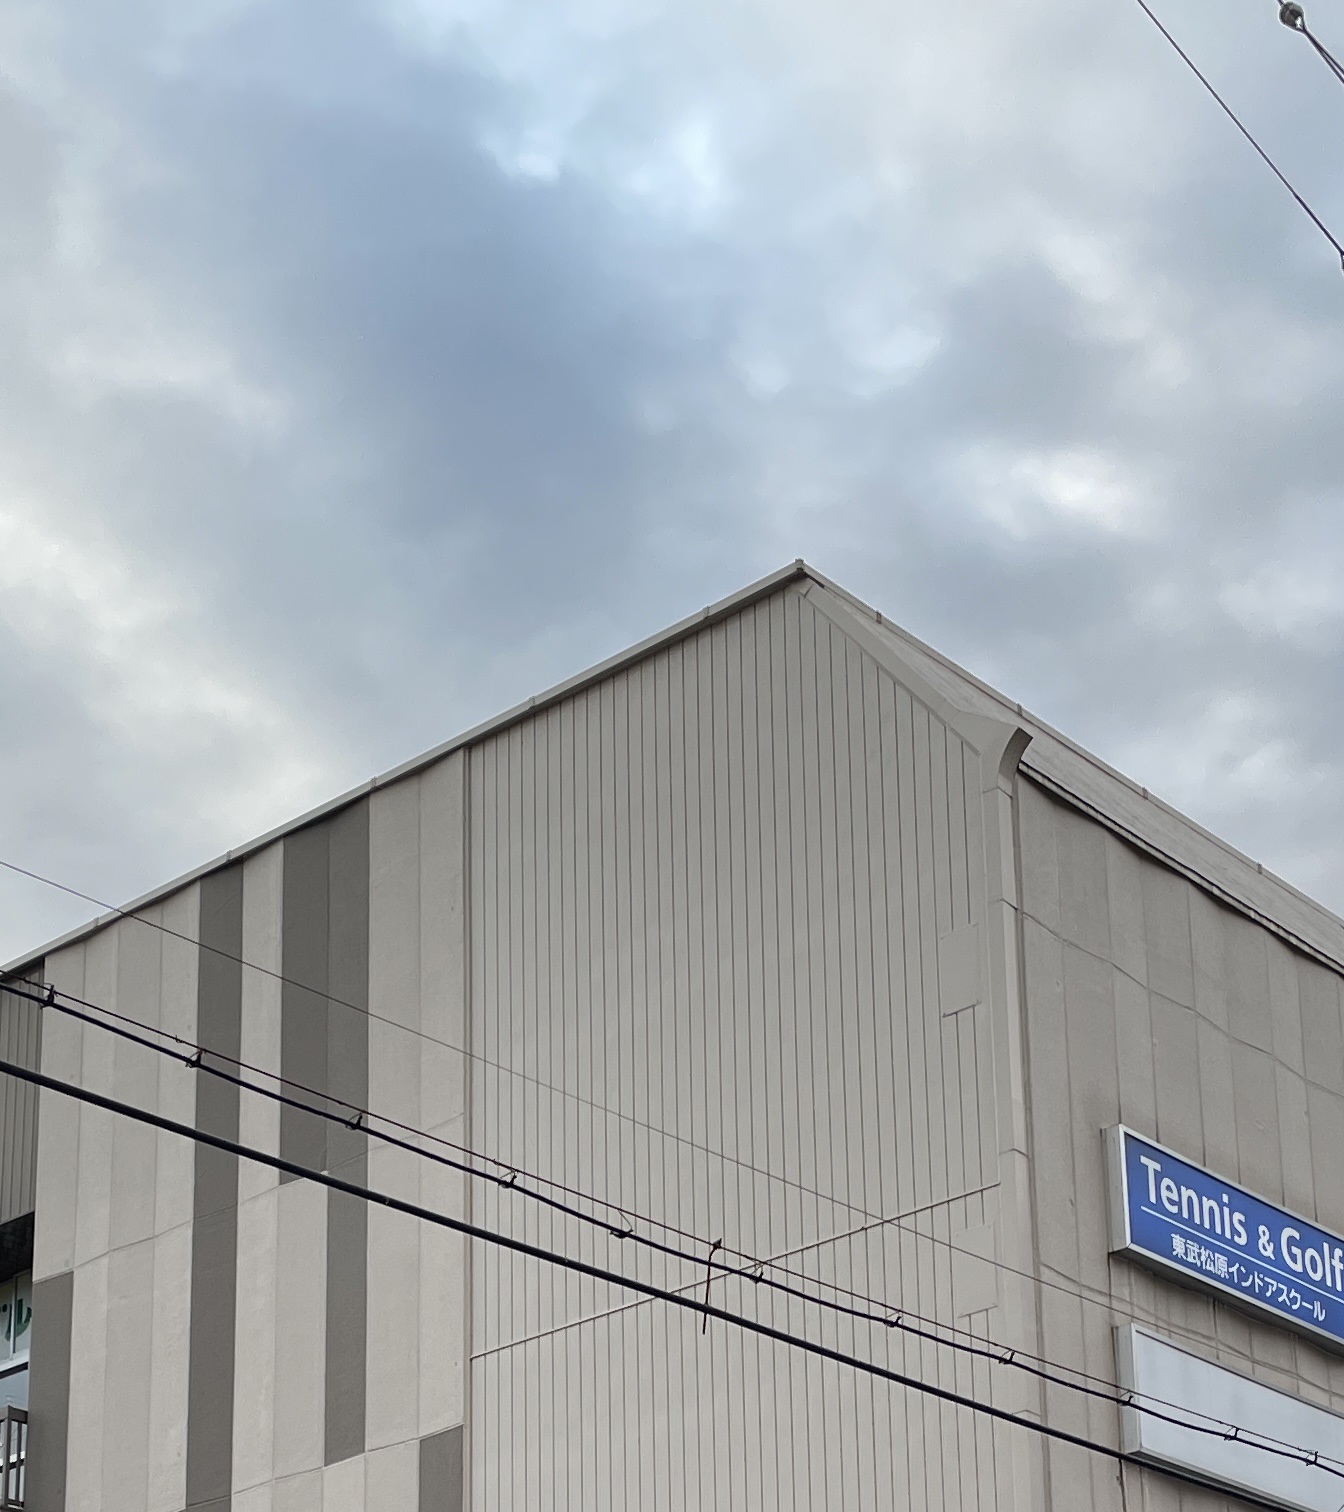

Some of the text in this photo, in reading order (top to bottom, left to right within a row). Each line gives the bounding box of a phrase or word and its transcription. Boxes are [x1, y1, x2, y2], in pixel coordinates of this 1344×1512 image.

[1140, 1155, 1344, 1292] Tennis & Golf
[1171, 1233, 1326, 1322] 東武松原インドアスクール
